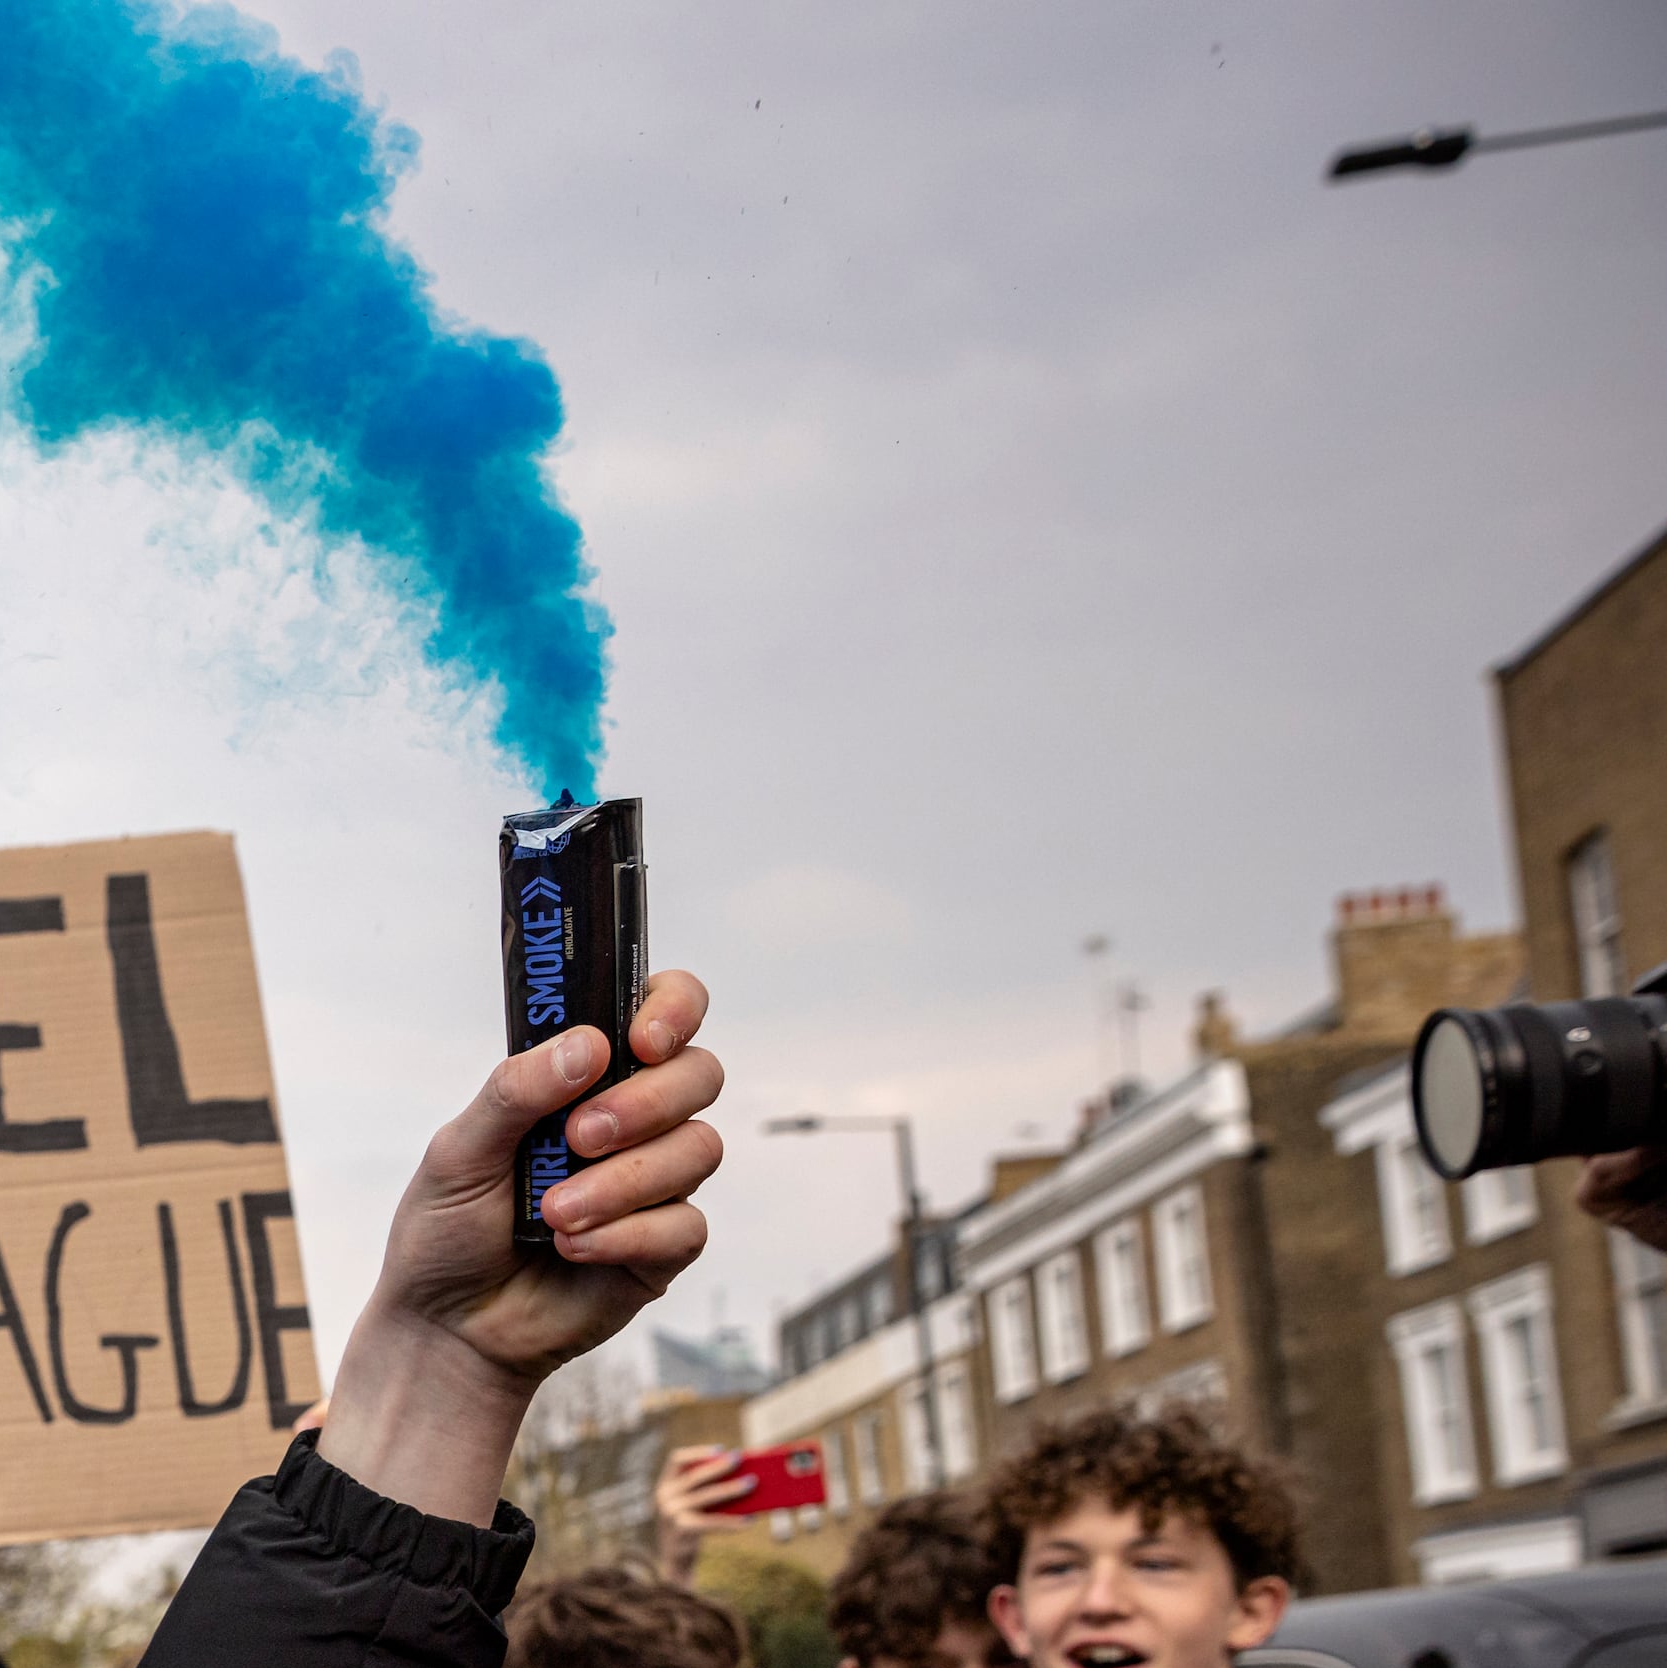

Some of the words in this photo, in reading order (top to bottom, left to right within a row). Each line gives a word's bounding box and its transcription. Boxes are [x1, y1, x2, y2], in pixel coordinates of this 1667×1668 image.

[564, 906, 575, 961] #ENOLAGAYE
[522, 907, 566, 1026] SMOKE
[630, 943, 639, 993] Enclosed
